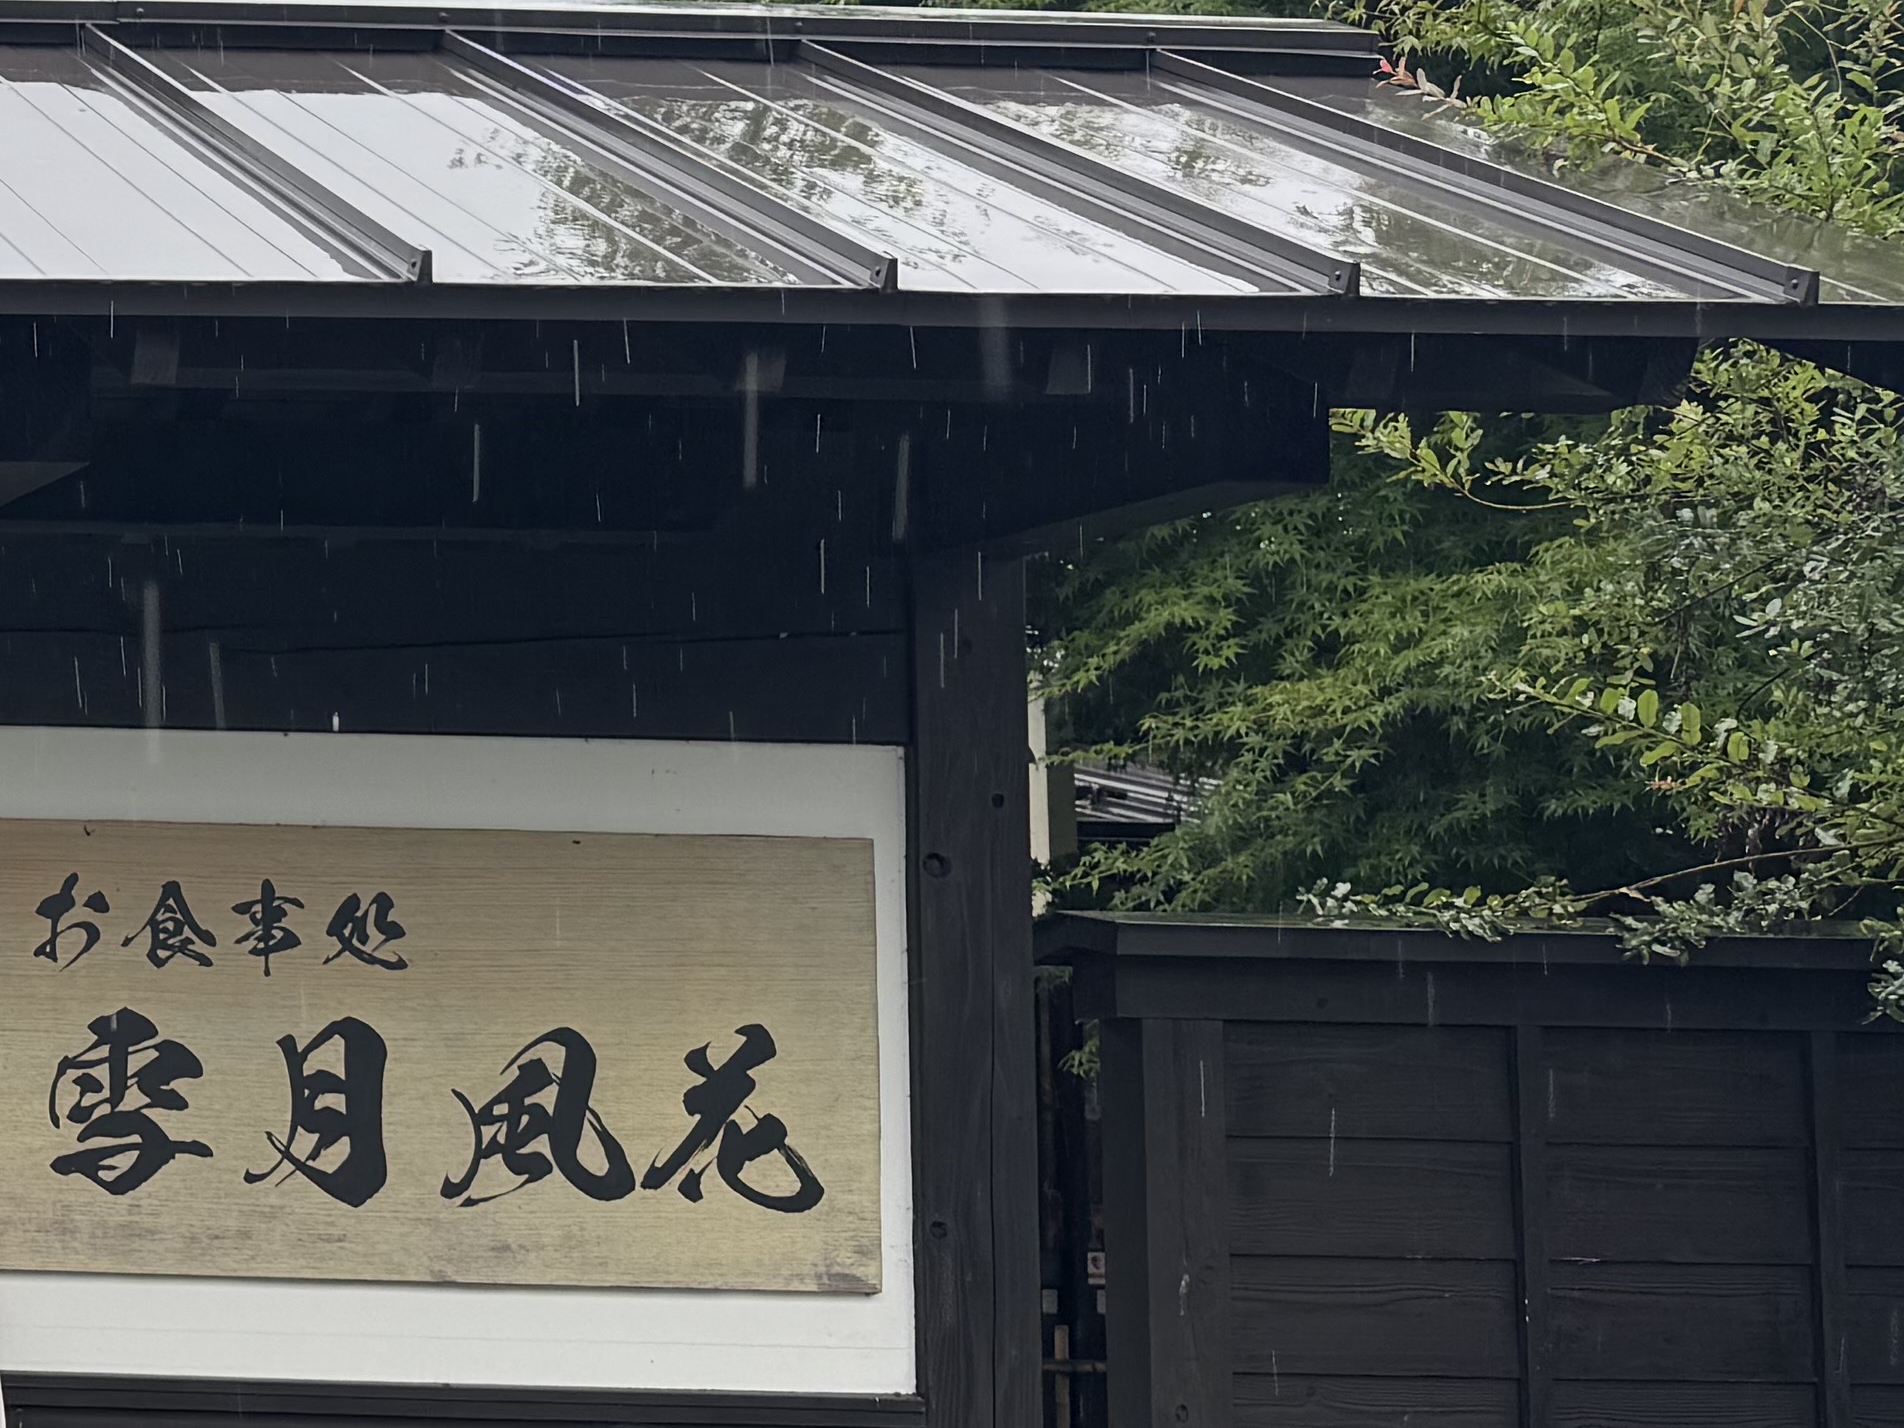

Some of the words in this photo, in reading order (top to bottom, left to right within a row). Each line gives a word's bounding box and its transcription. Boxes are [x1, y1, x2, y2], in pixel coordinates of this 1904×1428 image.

[33, 871, 409, 977] お食事処
[48, 1006, 826, 1214] 雪月風花
